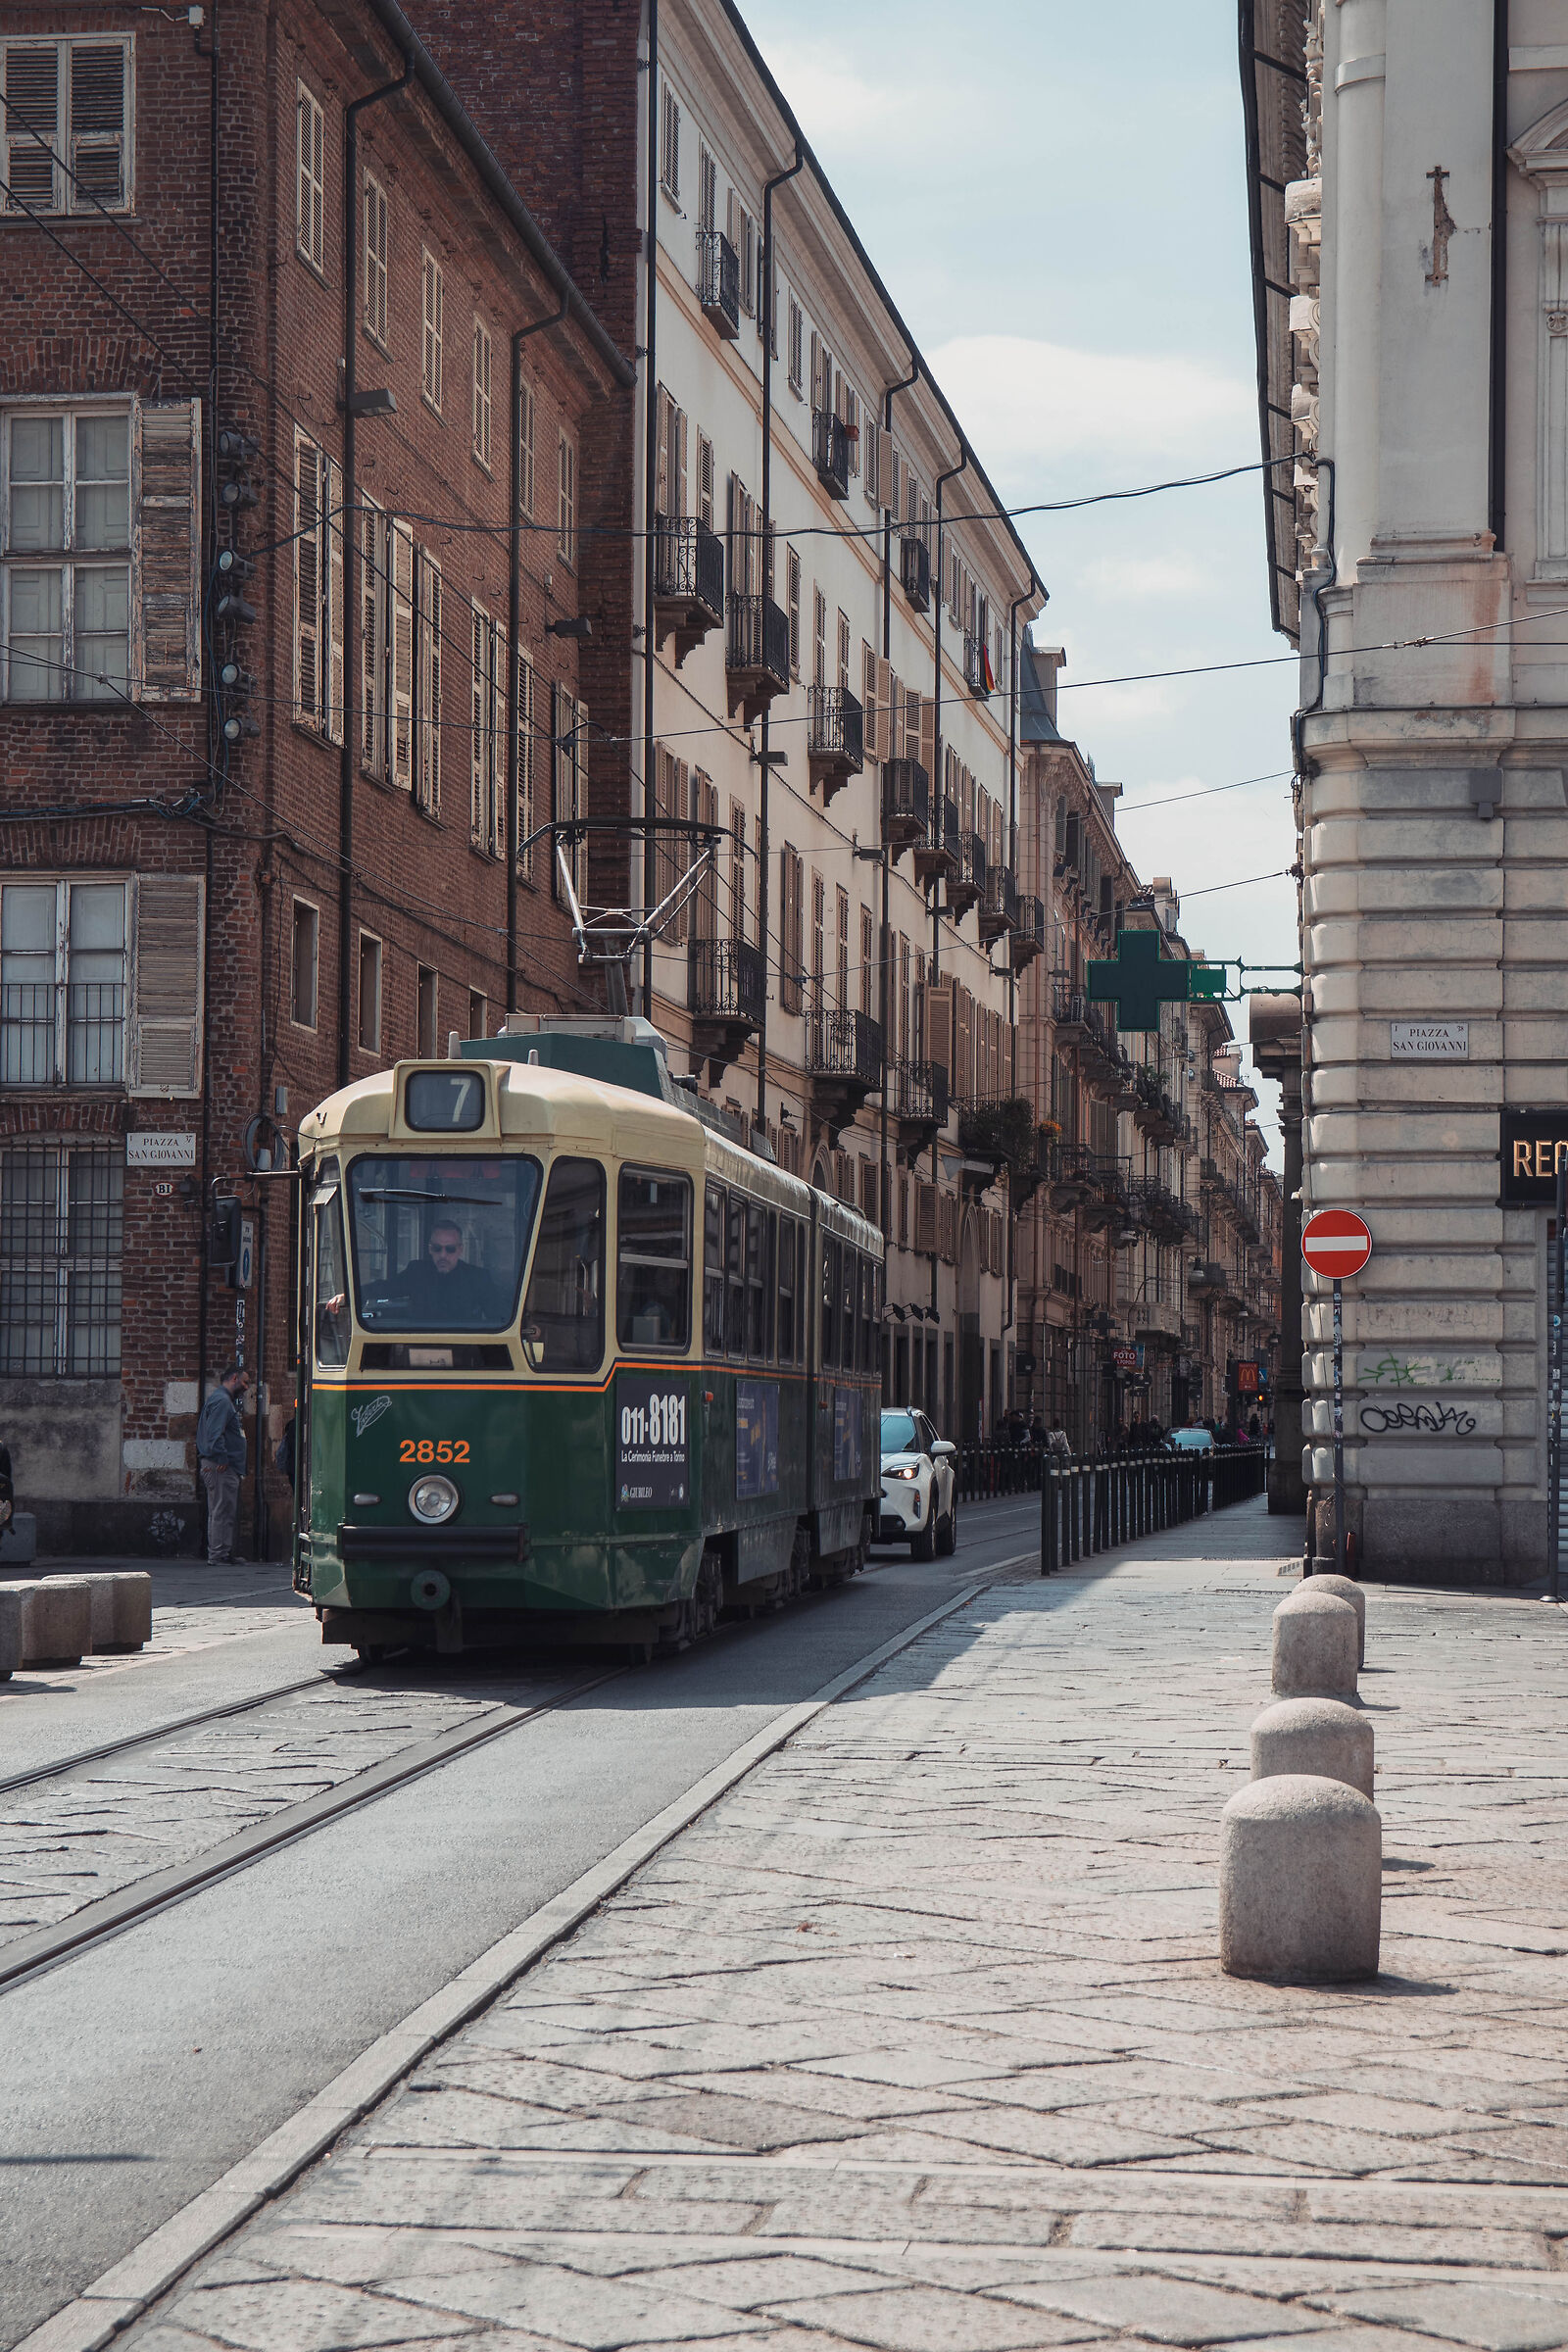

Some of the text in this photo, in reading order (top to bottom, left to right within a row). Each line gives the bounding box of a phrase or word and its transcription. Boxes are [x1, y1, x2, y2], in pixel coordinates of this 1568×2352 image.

[1409, 1028, 1449, 1038] PIAZZA
[1393, 1041, 1466, 1052] SAN GIOVANNI
[450, 1078, 471, 1123] 7
[143, 1138, 179, 1147] PIAZZA
[128, 1150, 193, 1159] SAN GIOVANNI
[1113, 1351, 1136, 1360] FOTO
[621, 1394, 686, 1446] 011-8181
[399, 1439, 470, 1463] 2852
[621, 1450, 628, 1462] La
[628, 1450, 652, 1462] Cerimonia
[652, 1450, 670, 1462] Funebre
[673, 1450, 686, 1462] Torino
